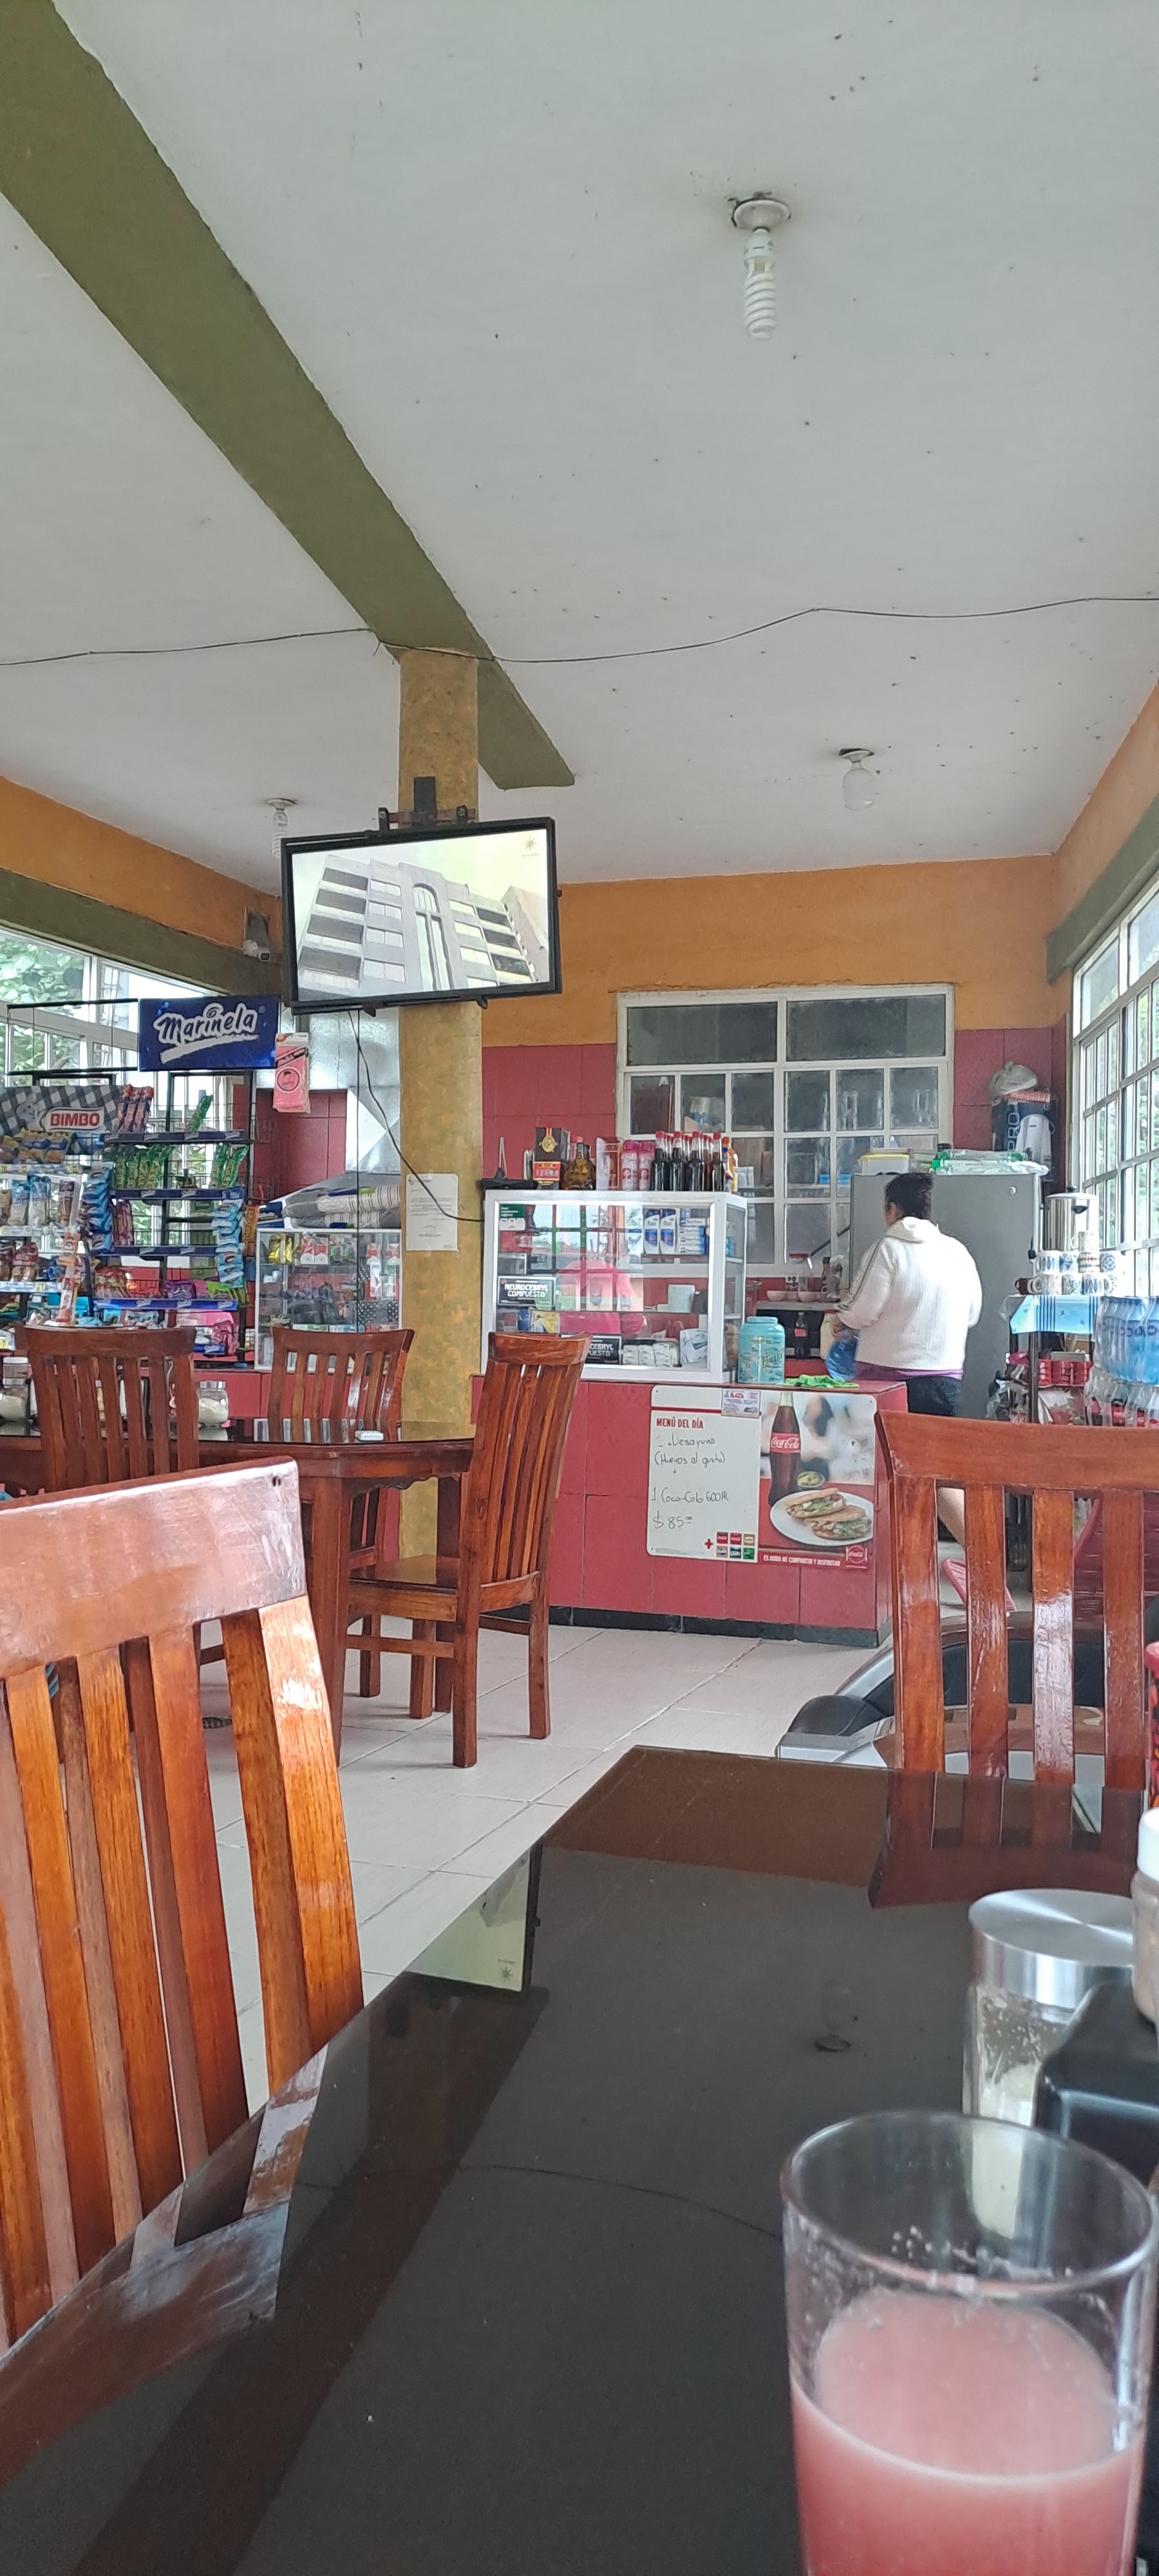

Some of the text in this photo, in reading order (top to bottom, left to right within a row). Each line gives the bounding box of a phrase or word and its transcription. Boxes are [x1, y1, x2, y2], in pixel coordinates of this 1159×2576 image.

[155, 1005, 256, 1045] Marinela
[50, 1113, 100, 1126] BIMBO
[505, 1283, 549, 1292] NEUROCEBRYL
[656, 1416, 704, 1429] MENÚ DEL DÍA
[690, 1452, 698, 1464] al
